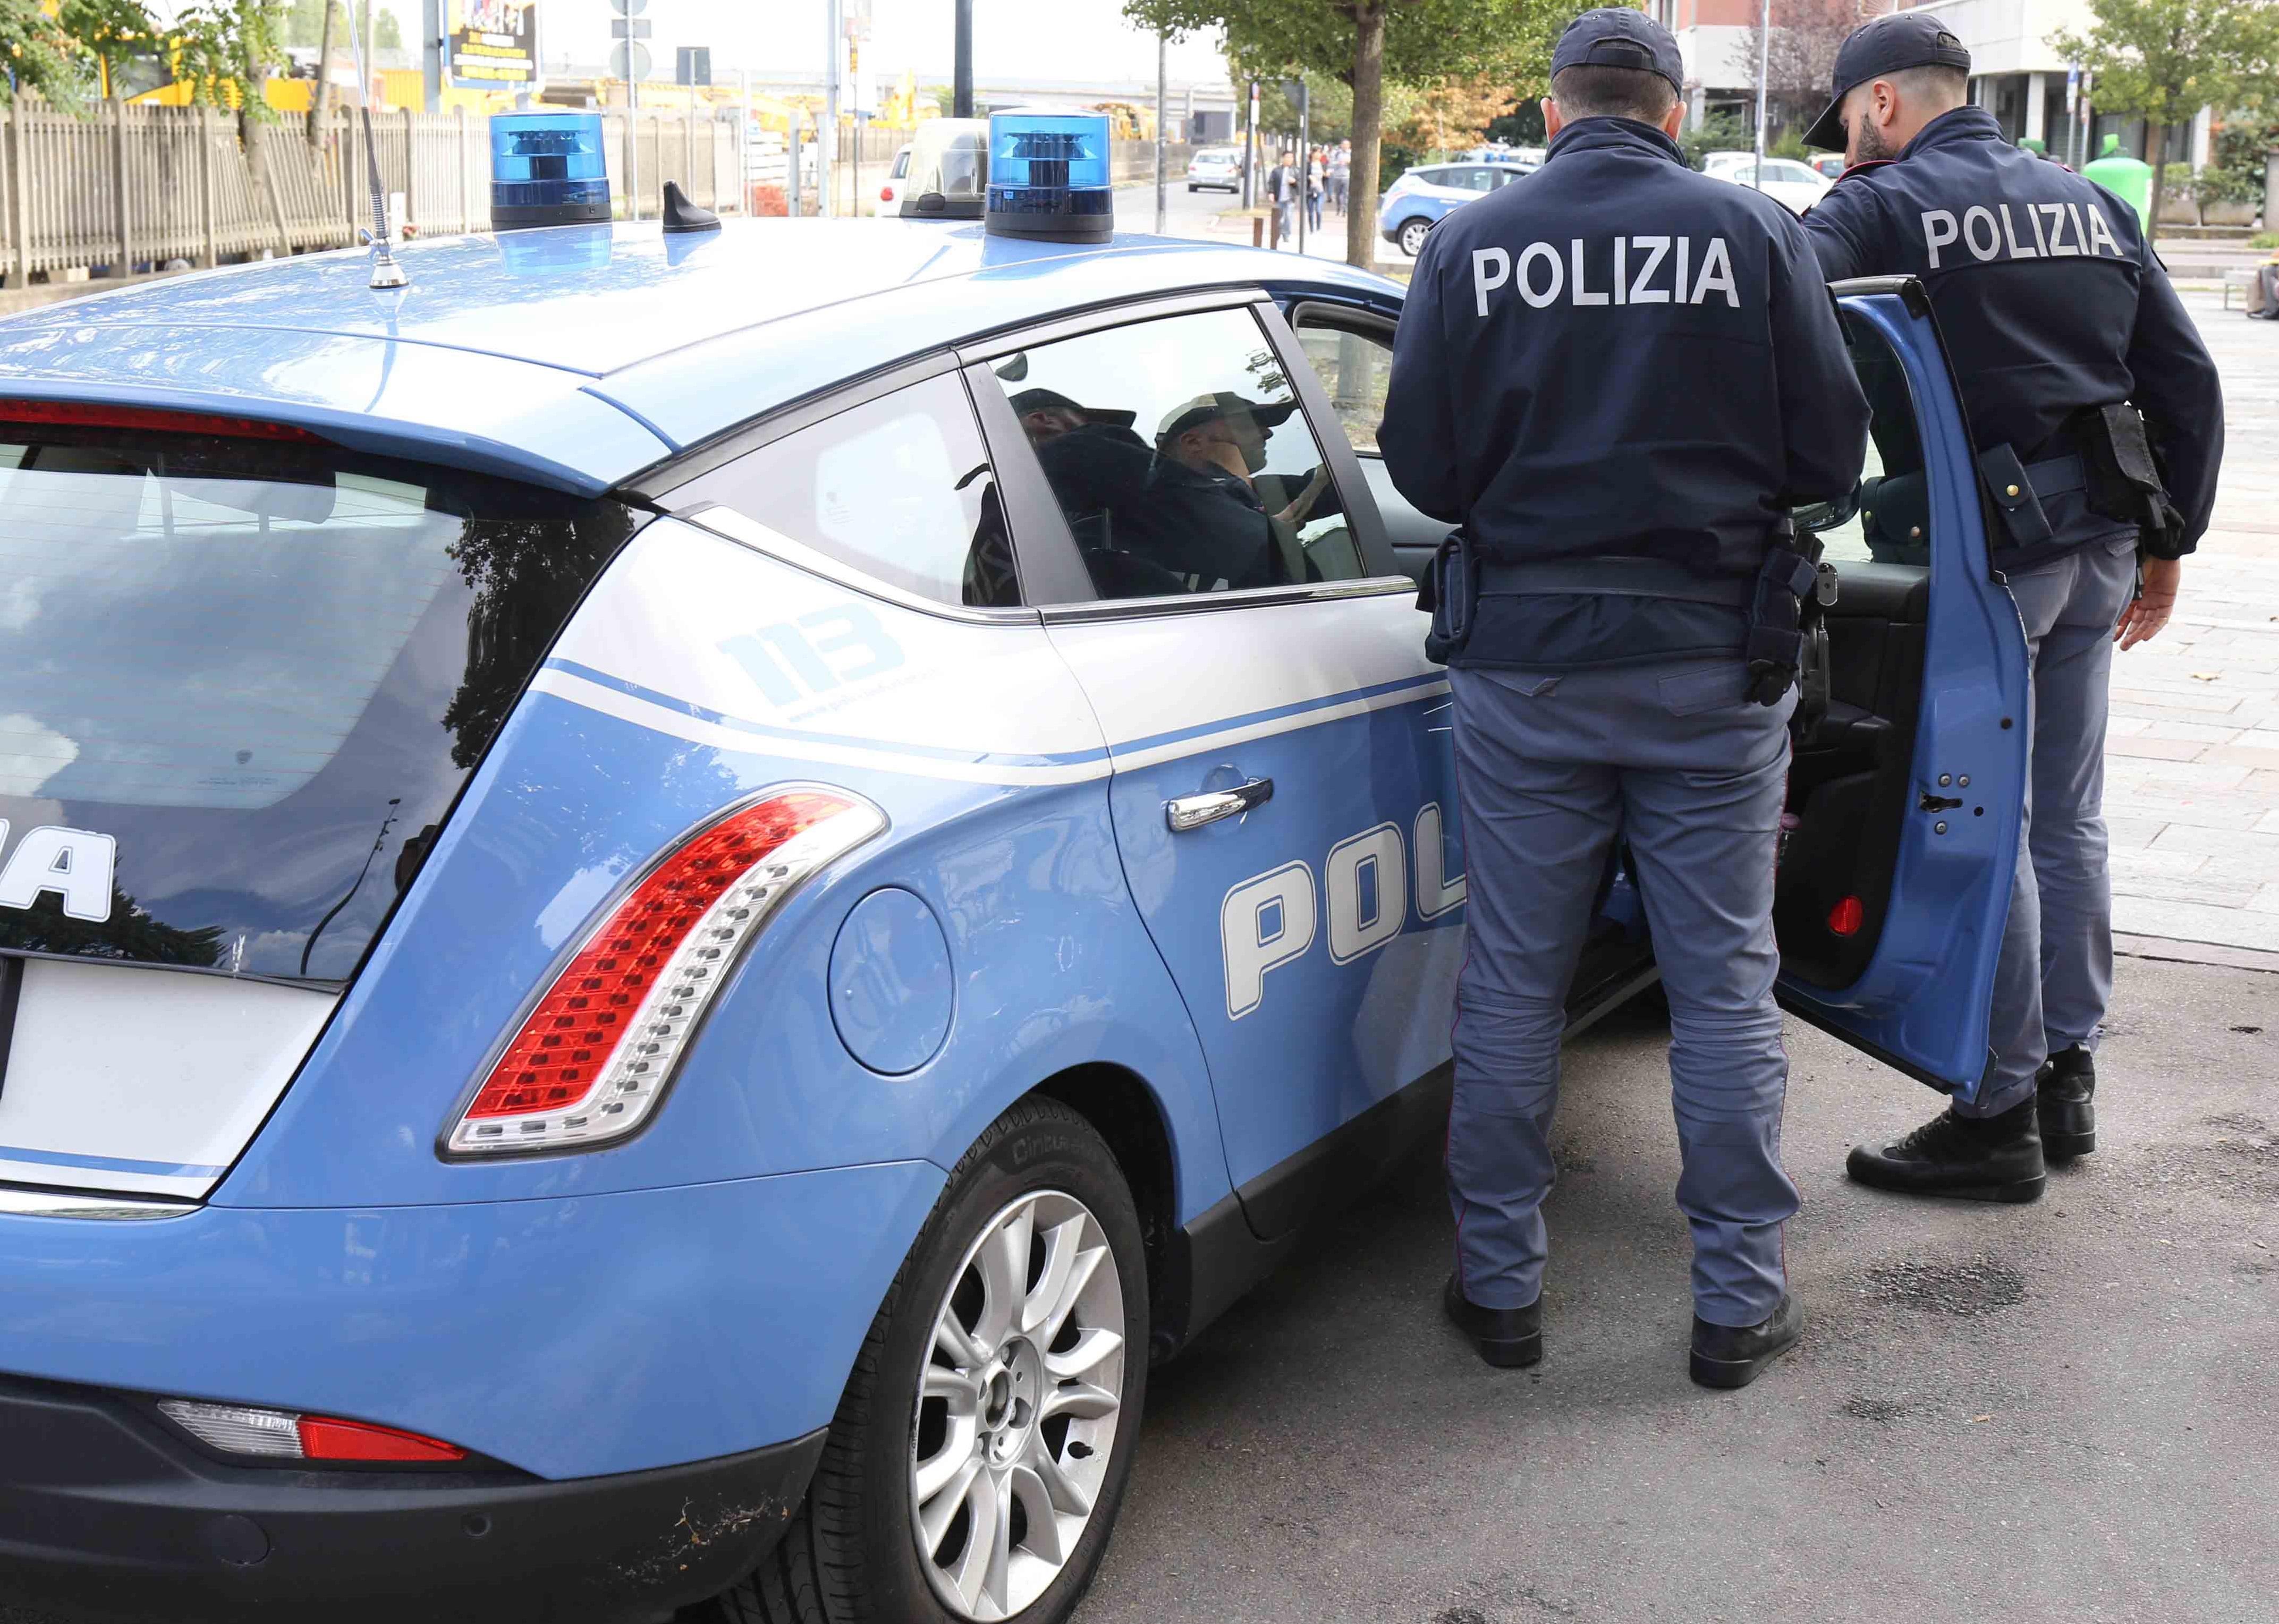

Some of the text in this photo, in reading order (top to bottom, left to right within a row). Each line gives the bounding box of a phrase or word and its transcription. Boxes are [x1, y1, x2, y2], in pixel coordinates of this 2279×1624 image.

[1472, 236, 1740, 317] POLIZIA
[1921, 203, 2124, 269] POLIZIA
[716, 602, 905, 707] 113
[0, 818, 116, 922] A
